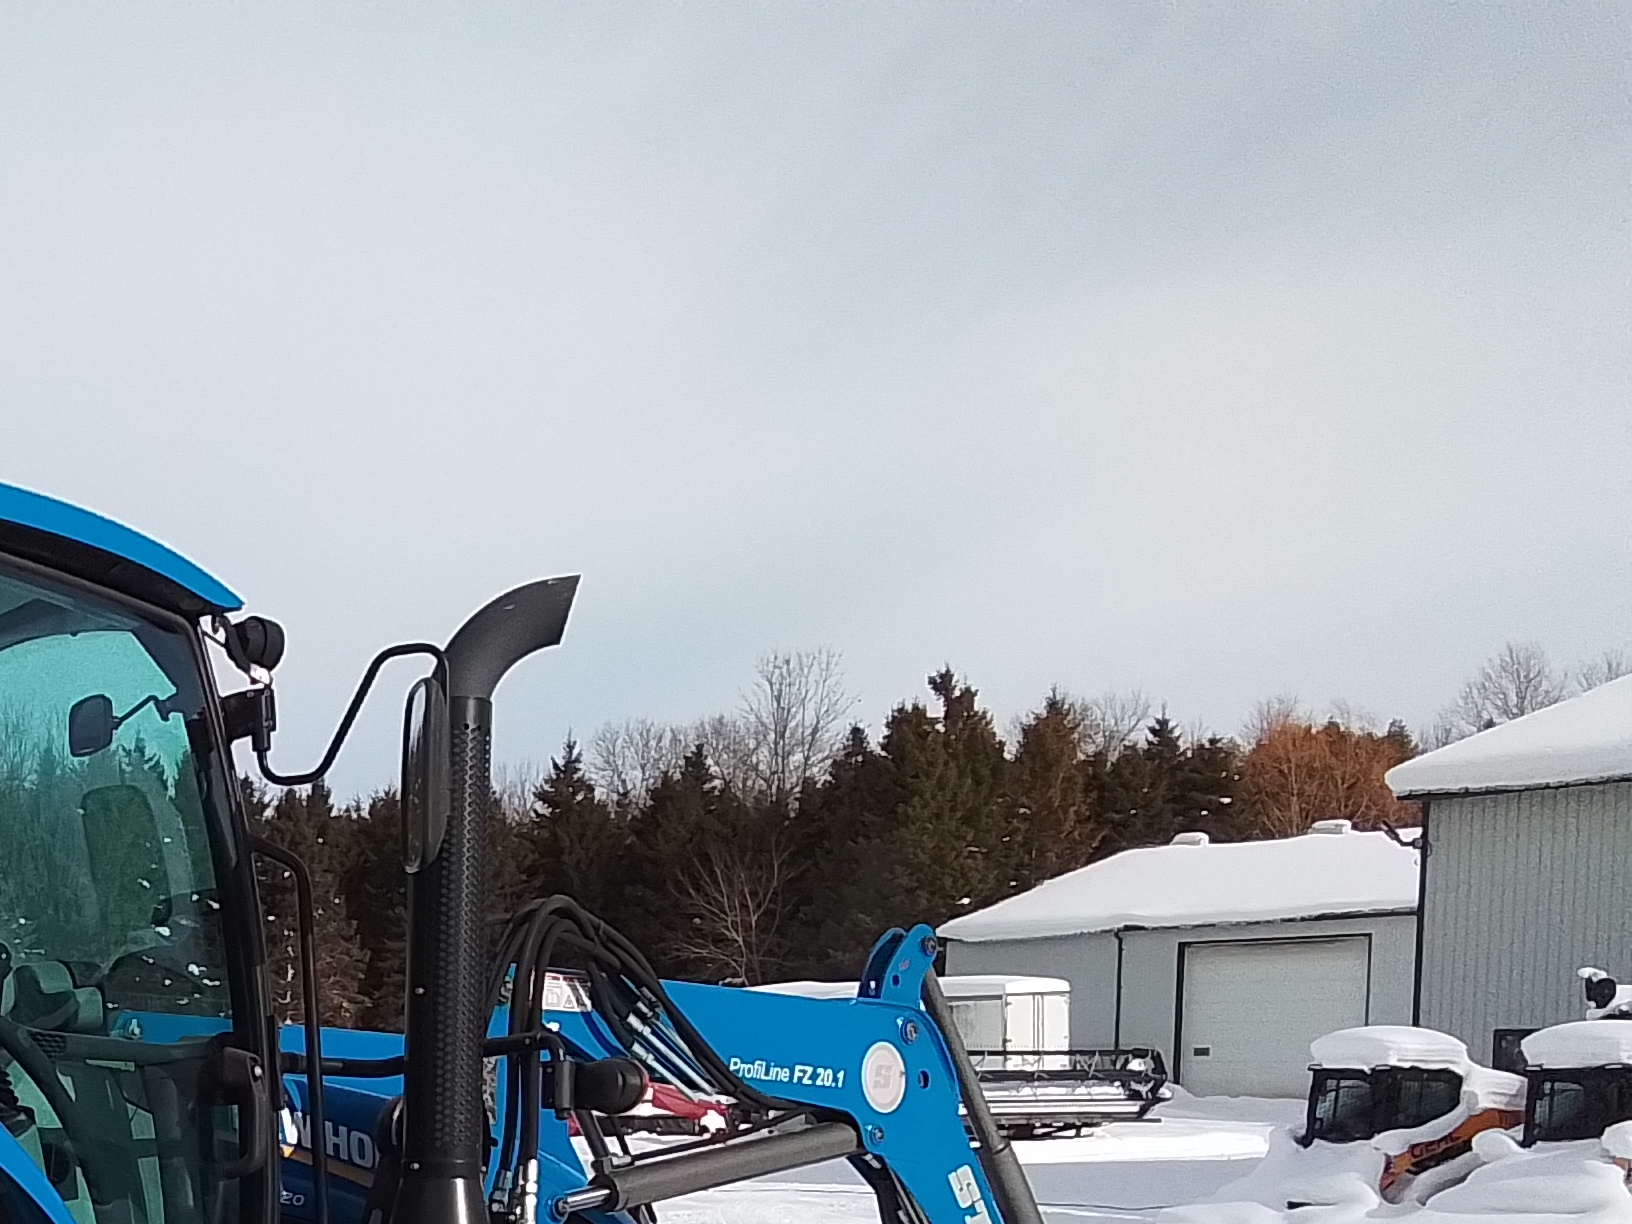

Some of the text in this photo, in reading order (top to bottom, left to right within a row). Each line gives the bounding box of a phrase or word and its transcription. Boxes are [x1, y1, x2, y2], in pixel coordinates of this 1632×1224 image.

[730, 1058, 845, 1089] ProfiLine FZ 20.1
[324, 1120, 381, 1169] HO
